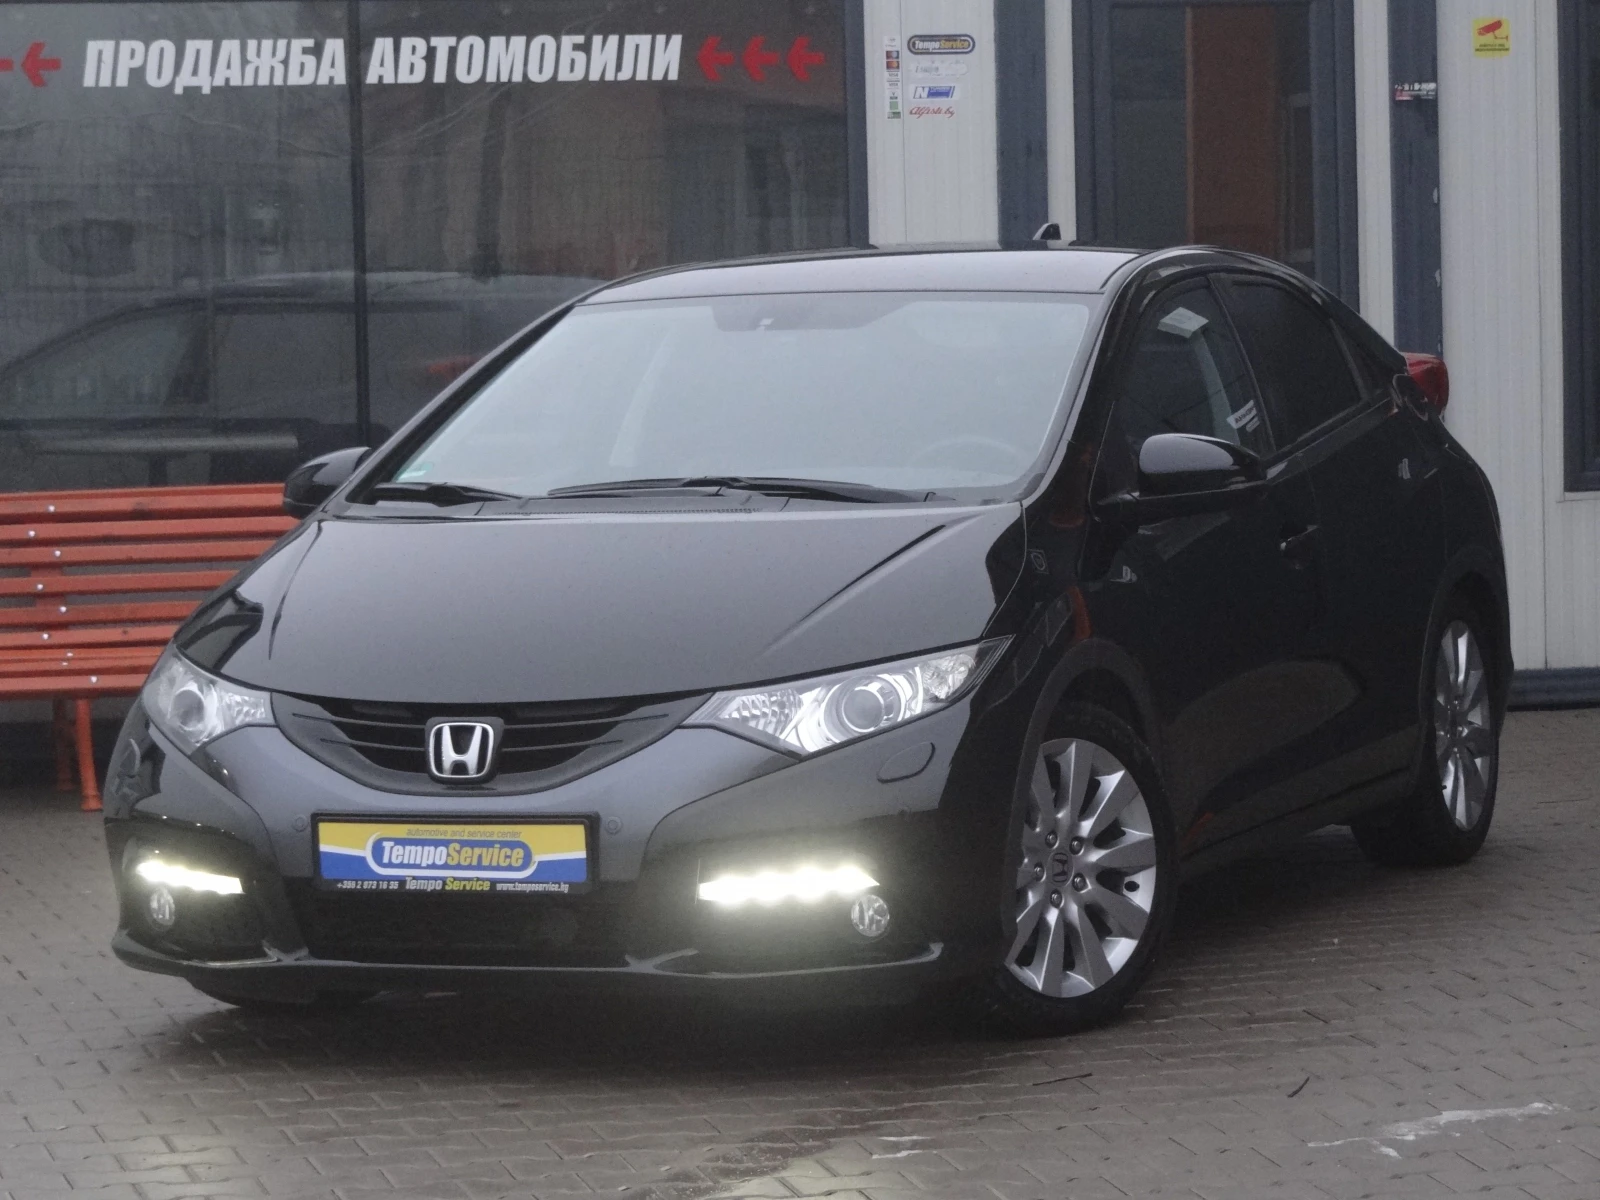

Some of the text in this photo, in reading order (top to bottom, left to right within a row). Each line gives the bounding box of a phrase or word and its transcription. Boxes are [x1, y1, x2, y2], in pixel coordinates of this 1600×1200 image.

[914, 39, 970, 51] TempoService
[82, 33, 683, 94] ПРОДАЖБА АВТОМОБИЛИ
[406, 827, 522, 838] automotive and service center
[382, 840, 524, 867] TempoService
[356, 881, 362, 889] 2
[405, 877, 491, 891] Tempo Service
[496, 882, 570, 893] www.temposervice.bg
